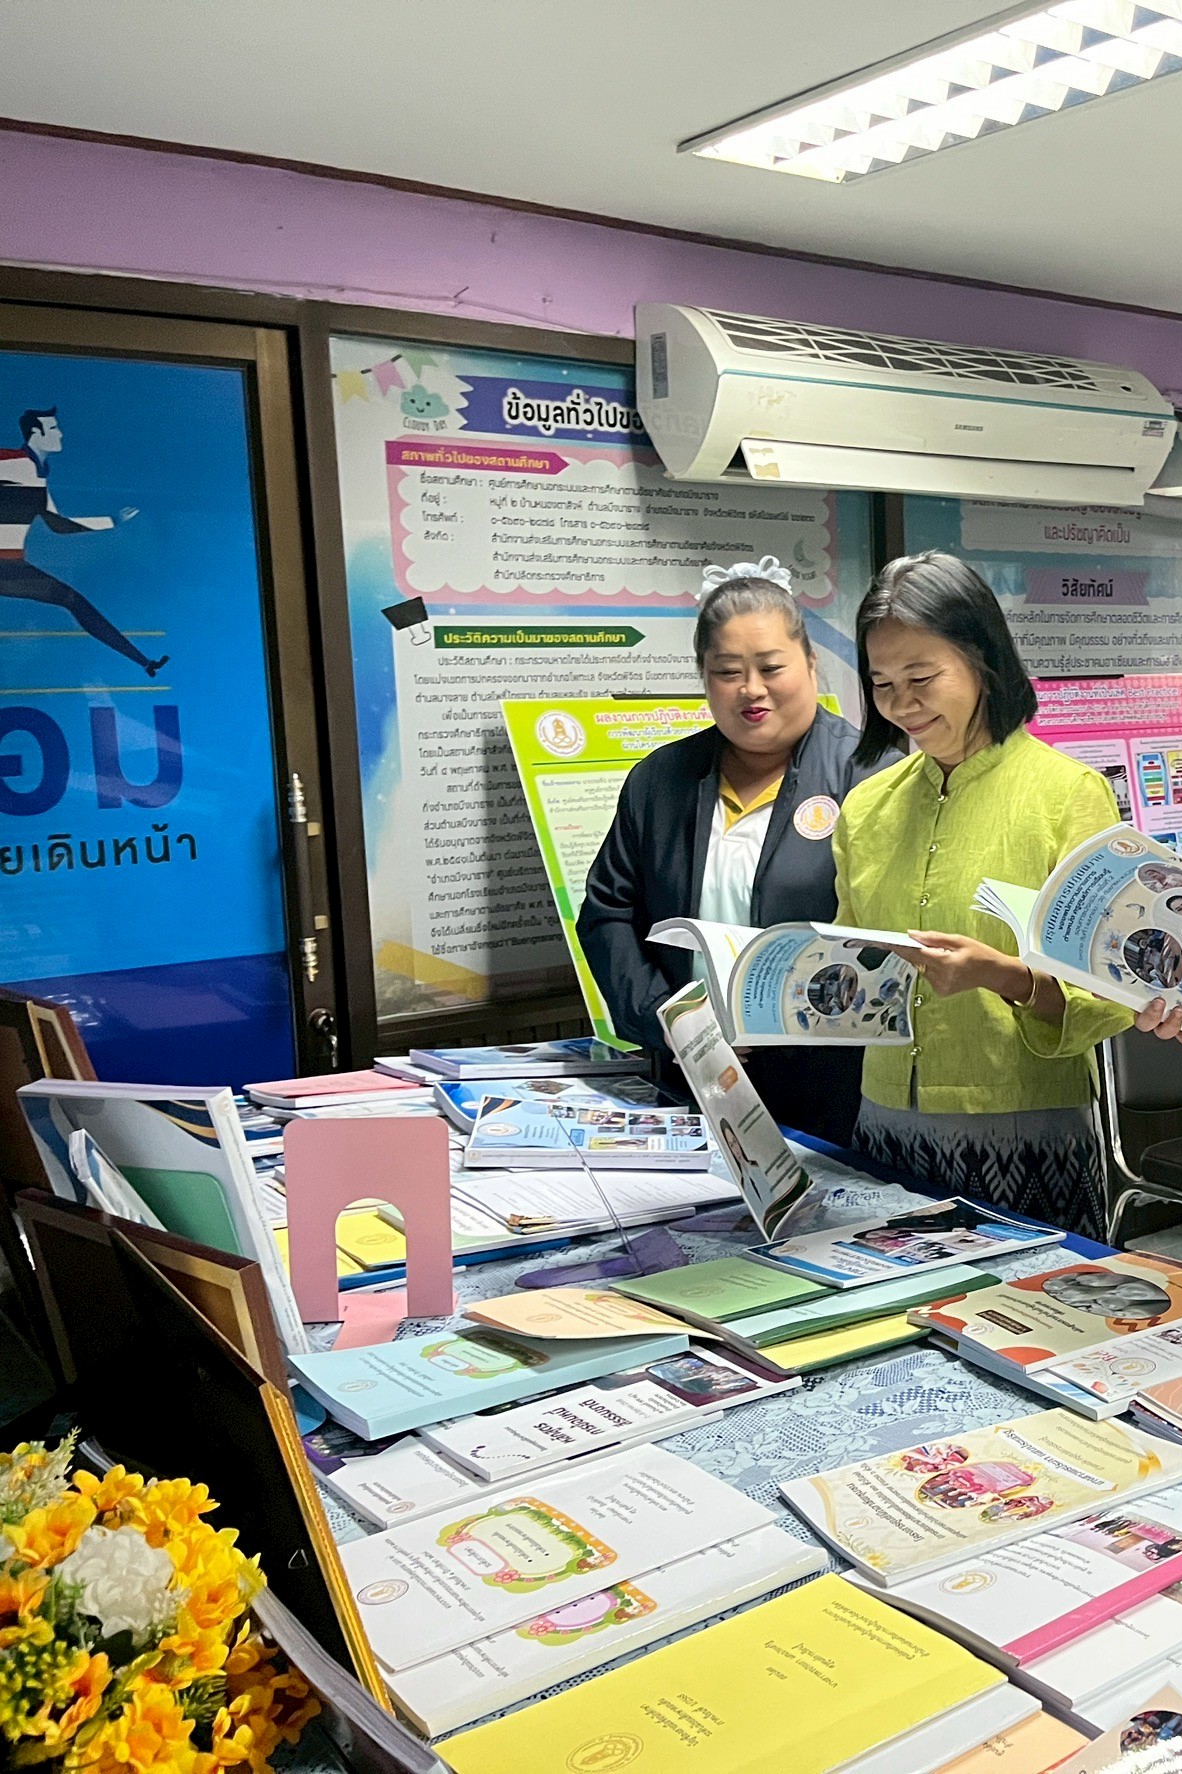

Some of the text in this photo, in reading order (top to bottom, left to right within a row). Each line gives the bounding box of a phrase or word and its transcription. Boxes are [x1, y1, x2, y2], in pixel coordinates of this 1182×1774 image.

[1061, 578, 1114, 598] วิสัยทัศน์
[533, 1420, 576, 1446] หลักสูตร
